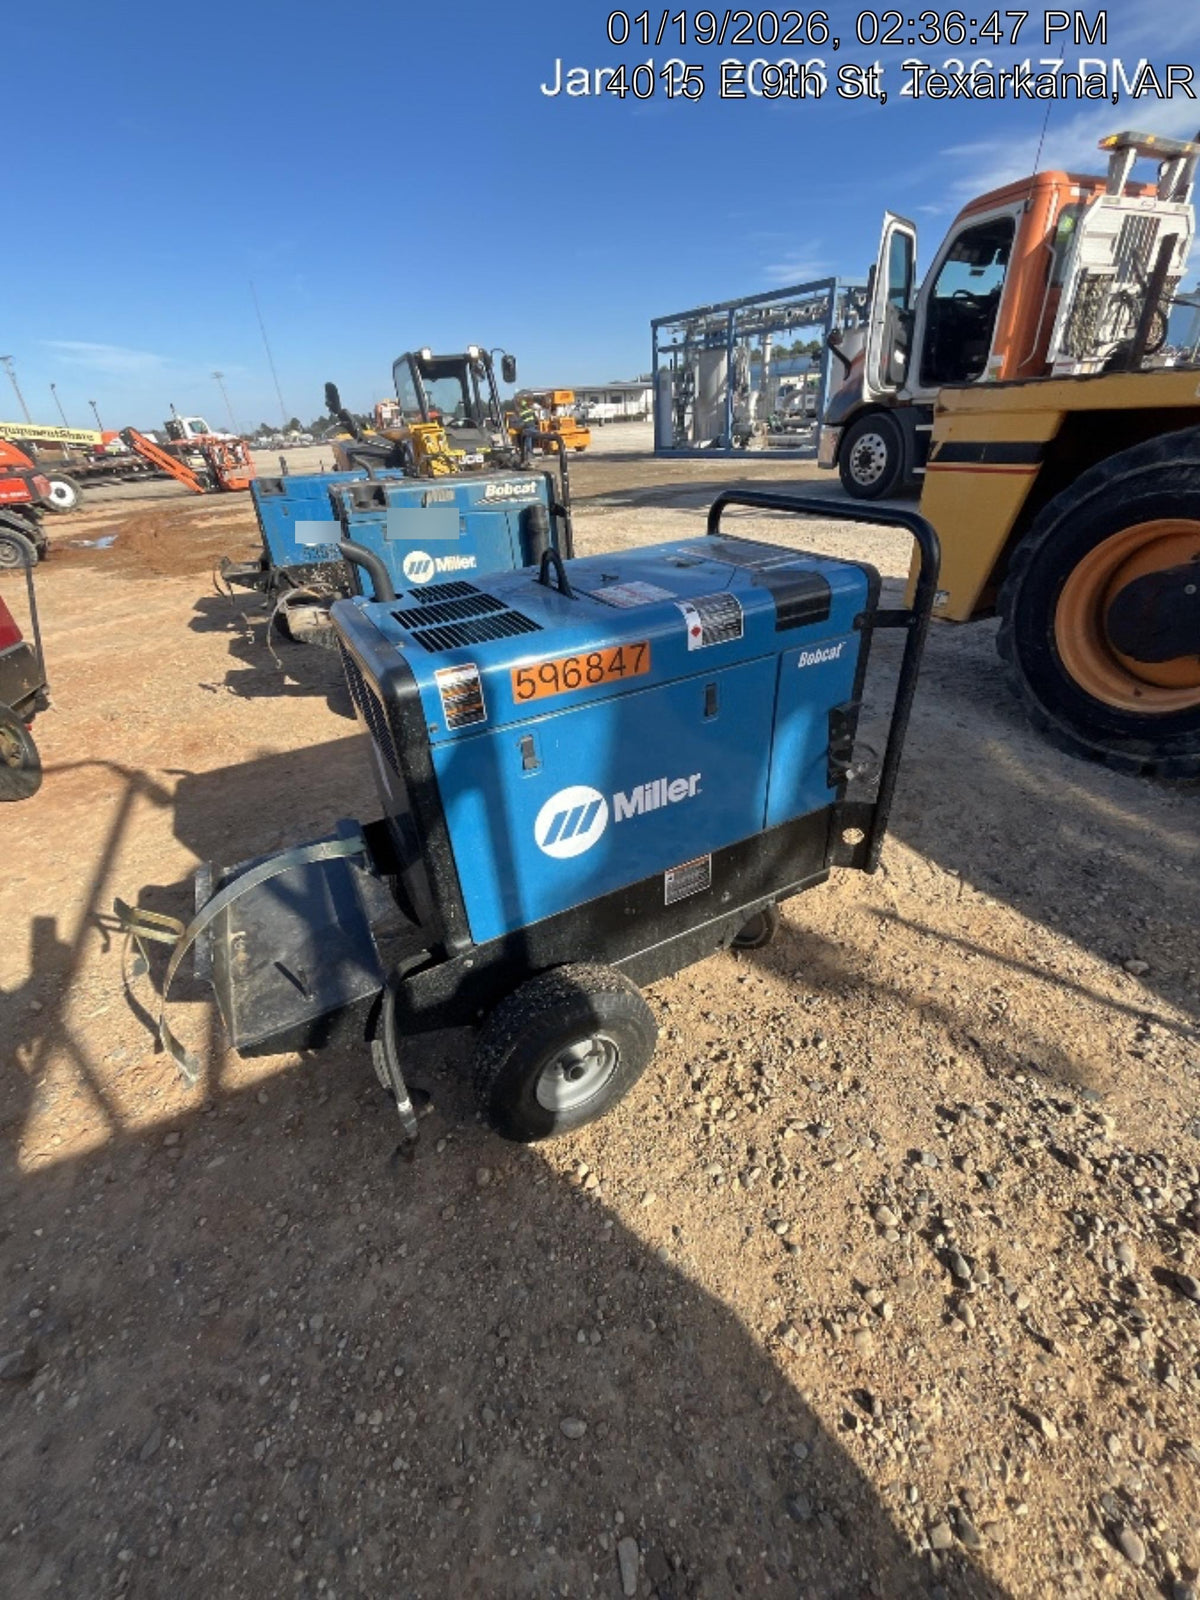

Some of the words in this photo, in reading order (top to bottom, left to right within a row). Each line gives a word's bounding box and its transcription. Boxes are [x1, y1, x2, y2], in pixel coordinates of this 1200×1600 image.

[485, 481, 537, 498] Bobcat
[434, 554, 477, 573] Miller
[798, 642, 842, 668] Bobcat
[515, 643, 648, 700] 596847
[613, 772, 702, 823] Miller
